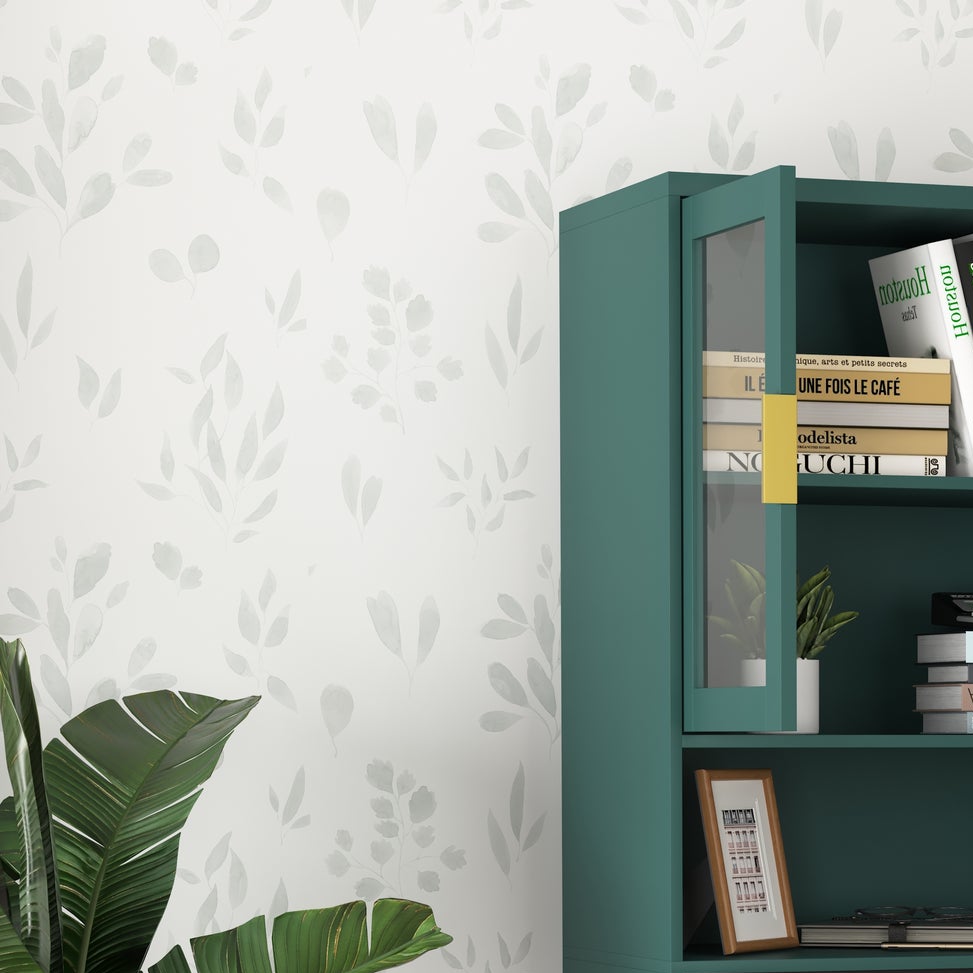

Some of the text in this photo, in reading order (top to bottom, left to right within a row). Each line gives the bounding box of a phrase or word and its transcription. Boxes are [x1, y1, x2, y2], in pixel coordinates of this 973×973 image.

[821, 358, 839, 366] arts
[851, 359, 875, 368] petits
[877, 360, 908, 368] secrets
[744, 375, 756, 392] IL
[799, 377, 822, 394] UNE
[825, 378, 851, 395] FOIS
[854, 379, 868, 395] LE
[871, 377, 901, 396] CAFÉ
